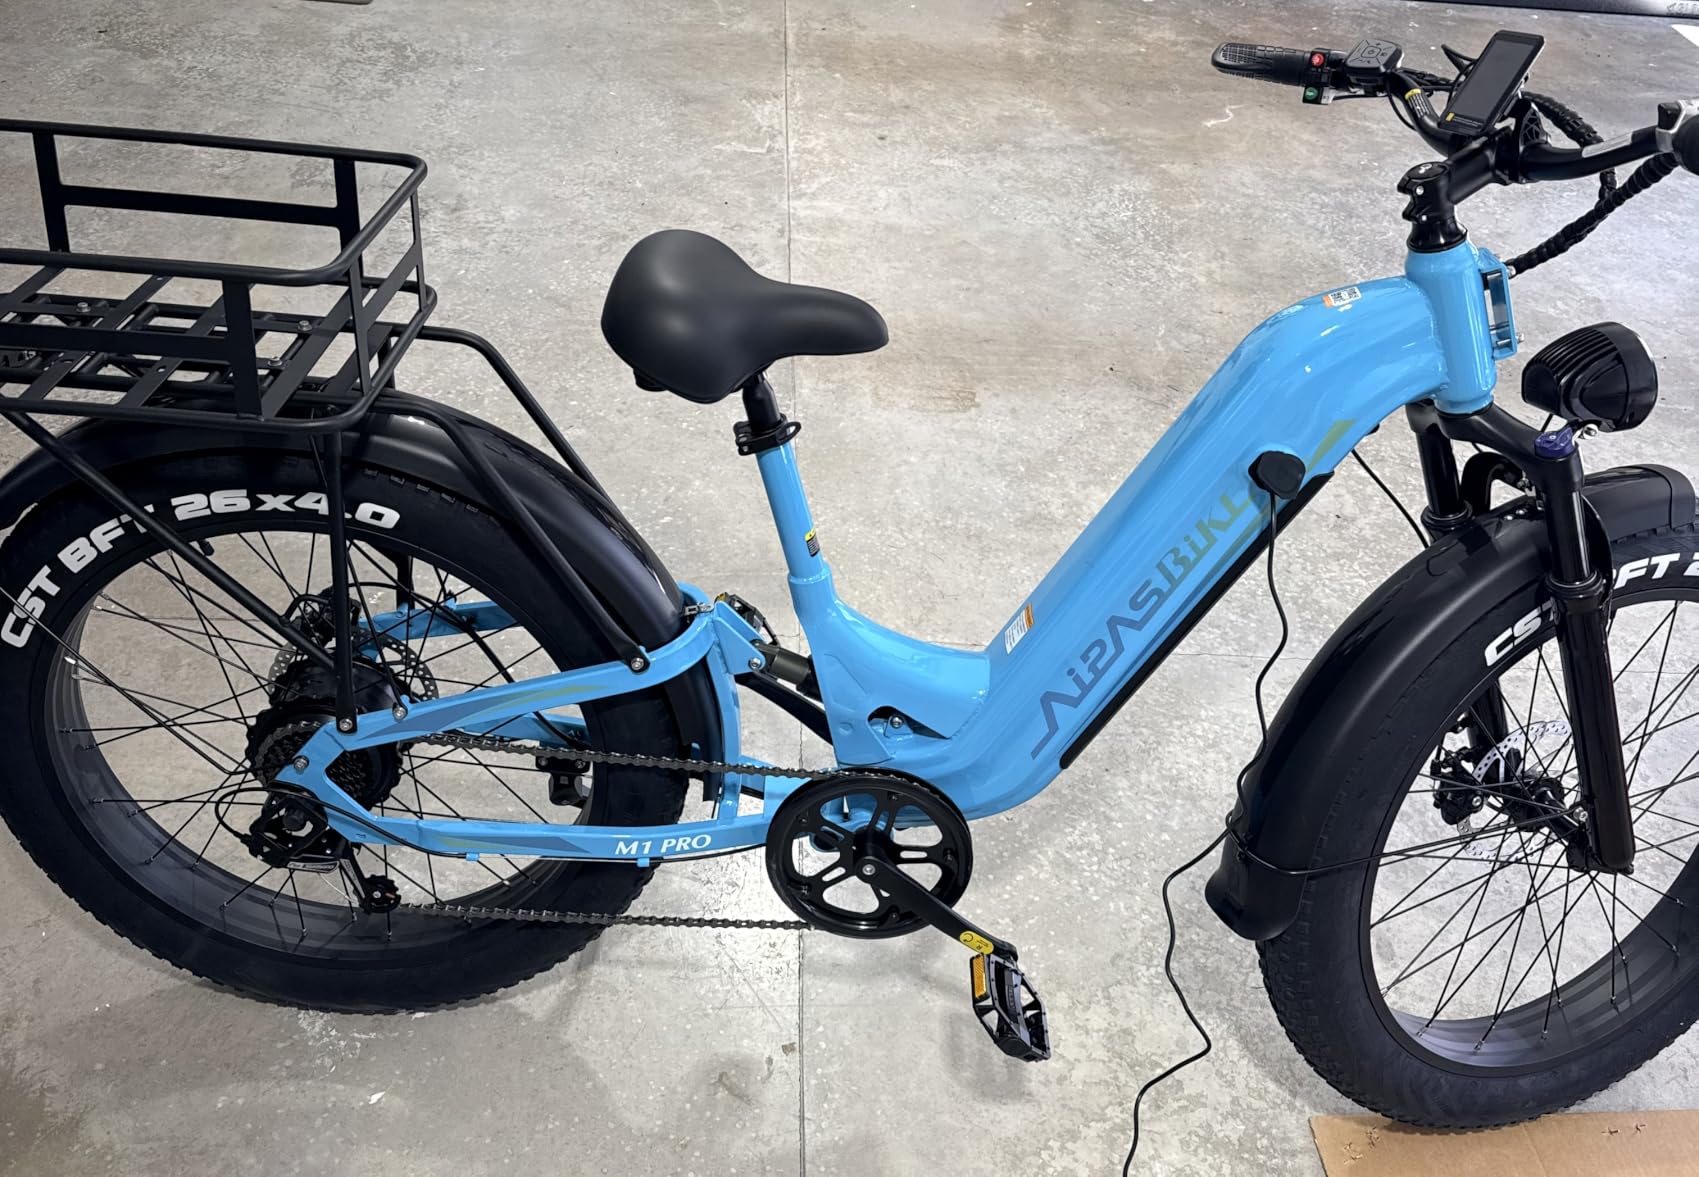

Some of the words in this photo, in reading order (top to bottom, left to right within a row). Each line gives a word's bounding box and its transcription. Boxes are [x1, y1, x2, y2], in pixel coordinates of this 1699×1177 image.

[1, 565, 61, 648] CST
[171, 489, 400, 529] 26x4.0
[1612, 552, 1681, 590] FT
[614, 840, 652, 856] M1
[660, 834, 712, 854] PRO
